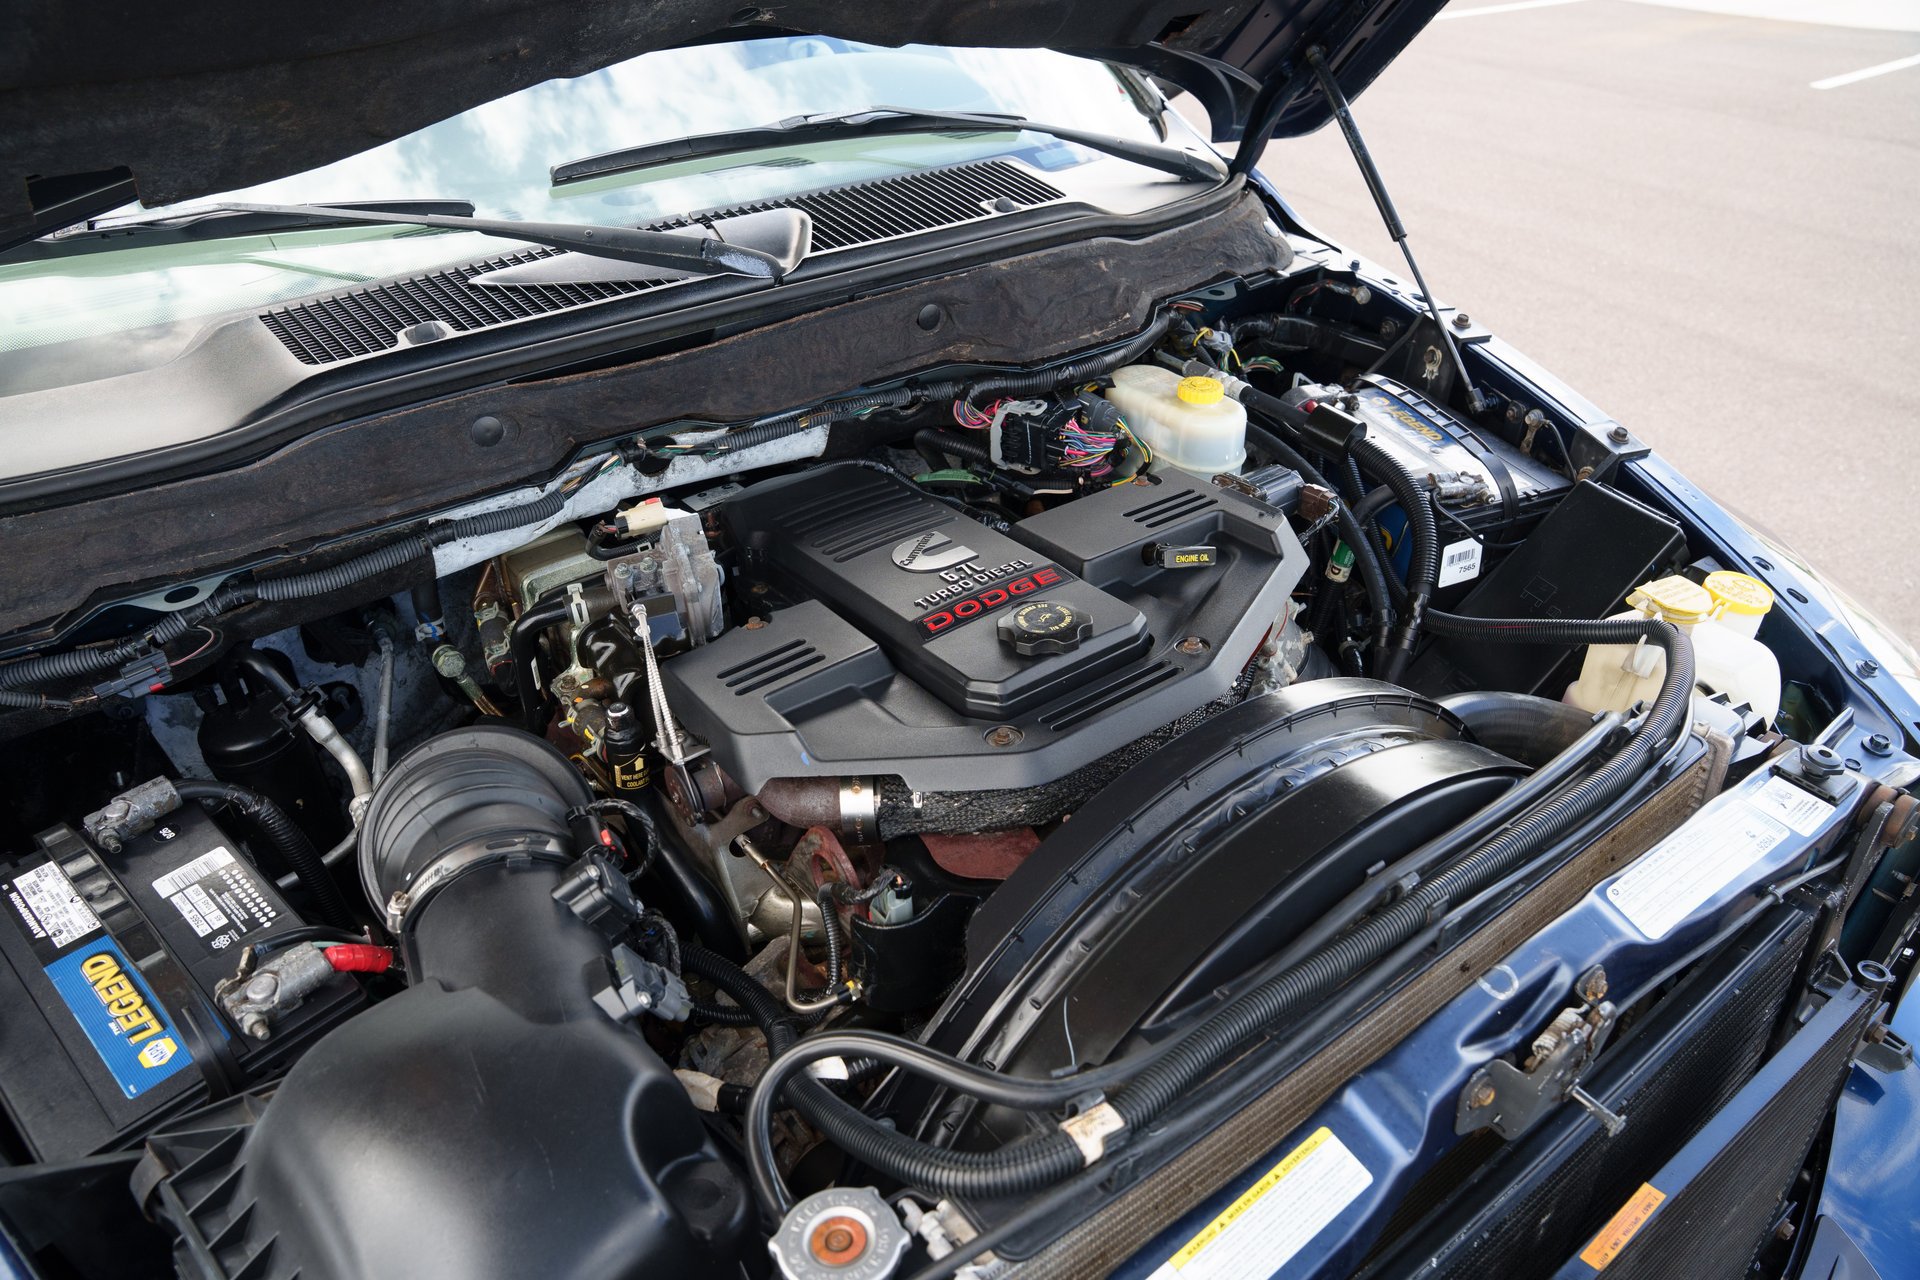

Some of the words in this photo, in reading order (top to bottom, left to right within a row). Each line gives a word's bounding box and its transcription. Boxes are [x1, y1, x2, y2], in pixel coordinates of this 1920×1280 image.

[1384, 405, 1443, 441] LEGEND
[900, 531, 936, 566] Cummins
[1175, 554, 1199, 563] ENGINE
[1199, 553, 1209, 562] OIL
[939, 562, 986, 584] 6.7L
[1458, 563, 1476, 574] 7565
[914, 580, 975, 610] TURBO
[973, 559, 1033, 586] DIESEL
[923, 567, 1063, 634] DODGE
[627, 777, 645, 788] COOLANT
[632, 772, 643, 780] HERE
[159, 827, 176, 840] 8/26
[80, 952, 165, 1047] LEGEND
[108, 1022, 121, 1036] THE
[146, 1039, 168, 1064] NAPA
